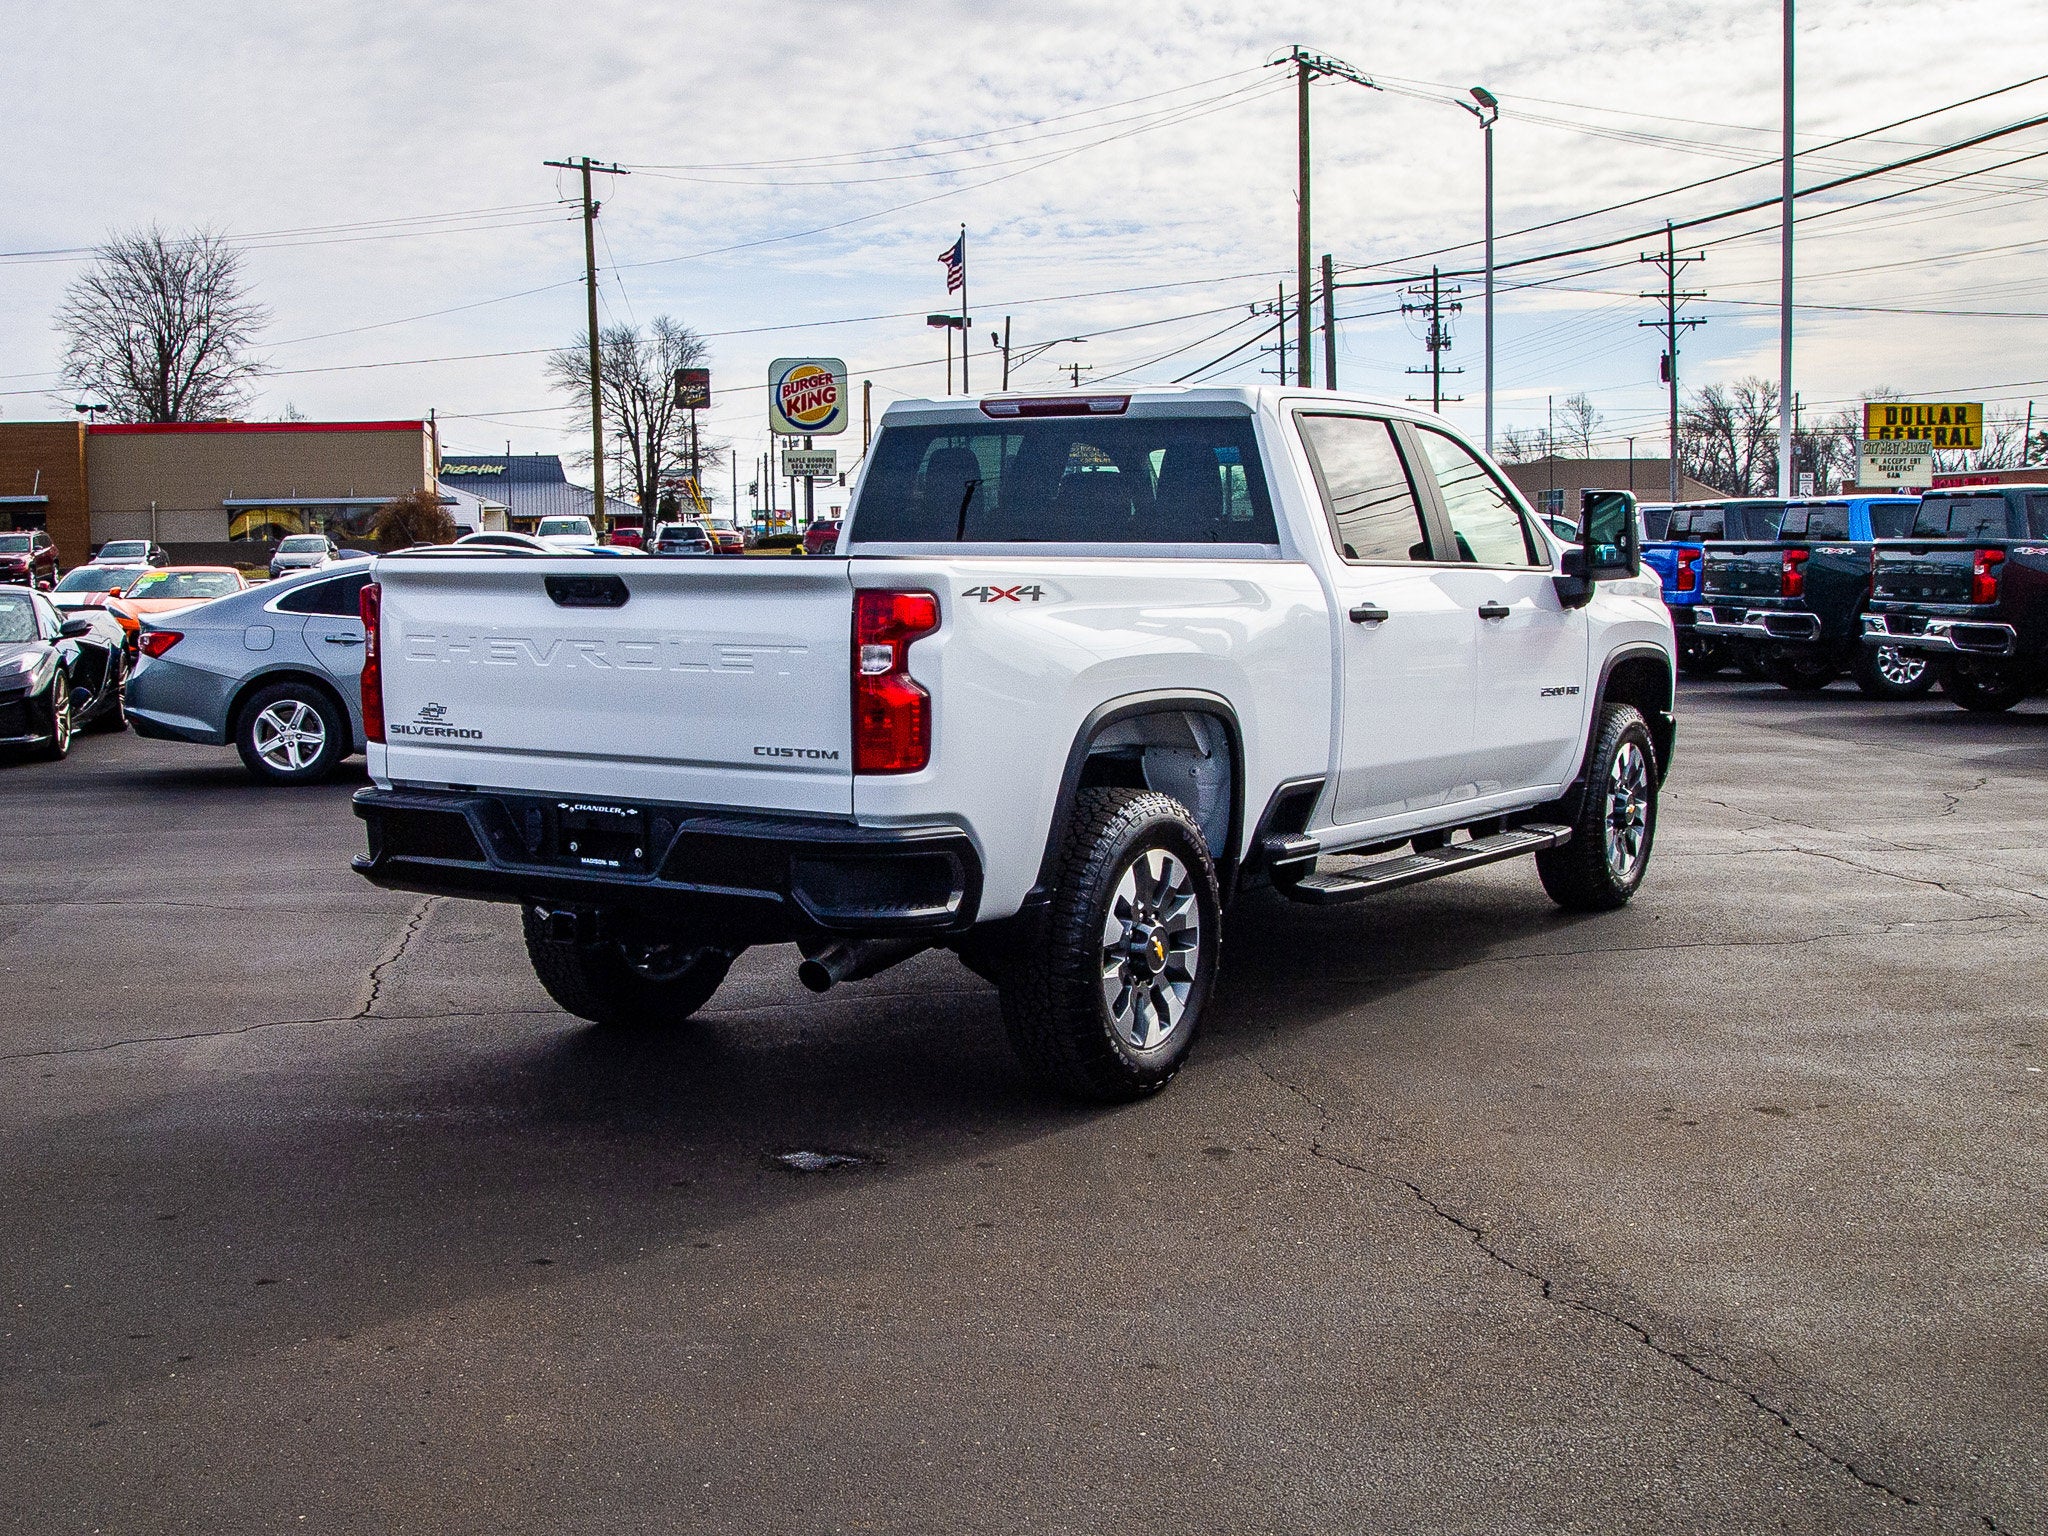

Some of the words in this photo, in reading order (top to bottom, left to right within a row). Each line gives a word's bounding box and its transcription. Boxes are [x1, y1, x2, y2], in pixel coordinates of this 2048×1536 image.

[783, 373, 833, 399] BURGER
[786, 387, 837, 417] KING
[1885, 406, 1967, 425] DOLLAR
[1879, 426, 1974, 446] GENERAL
[1878, 464, 1915, 472] BREAKFAST
[1882, 457, 1907, 465] ACCEPT
[405, 633, 809, 676] CHEVROLET
[390, 724, 483, 739] SILVERADO
[753, 746, 840, 760] CUSTOM
[574, 804, 622, 814] CHANDLER
